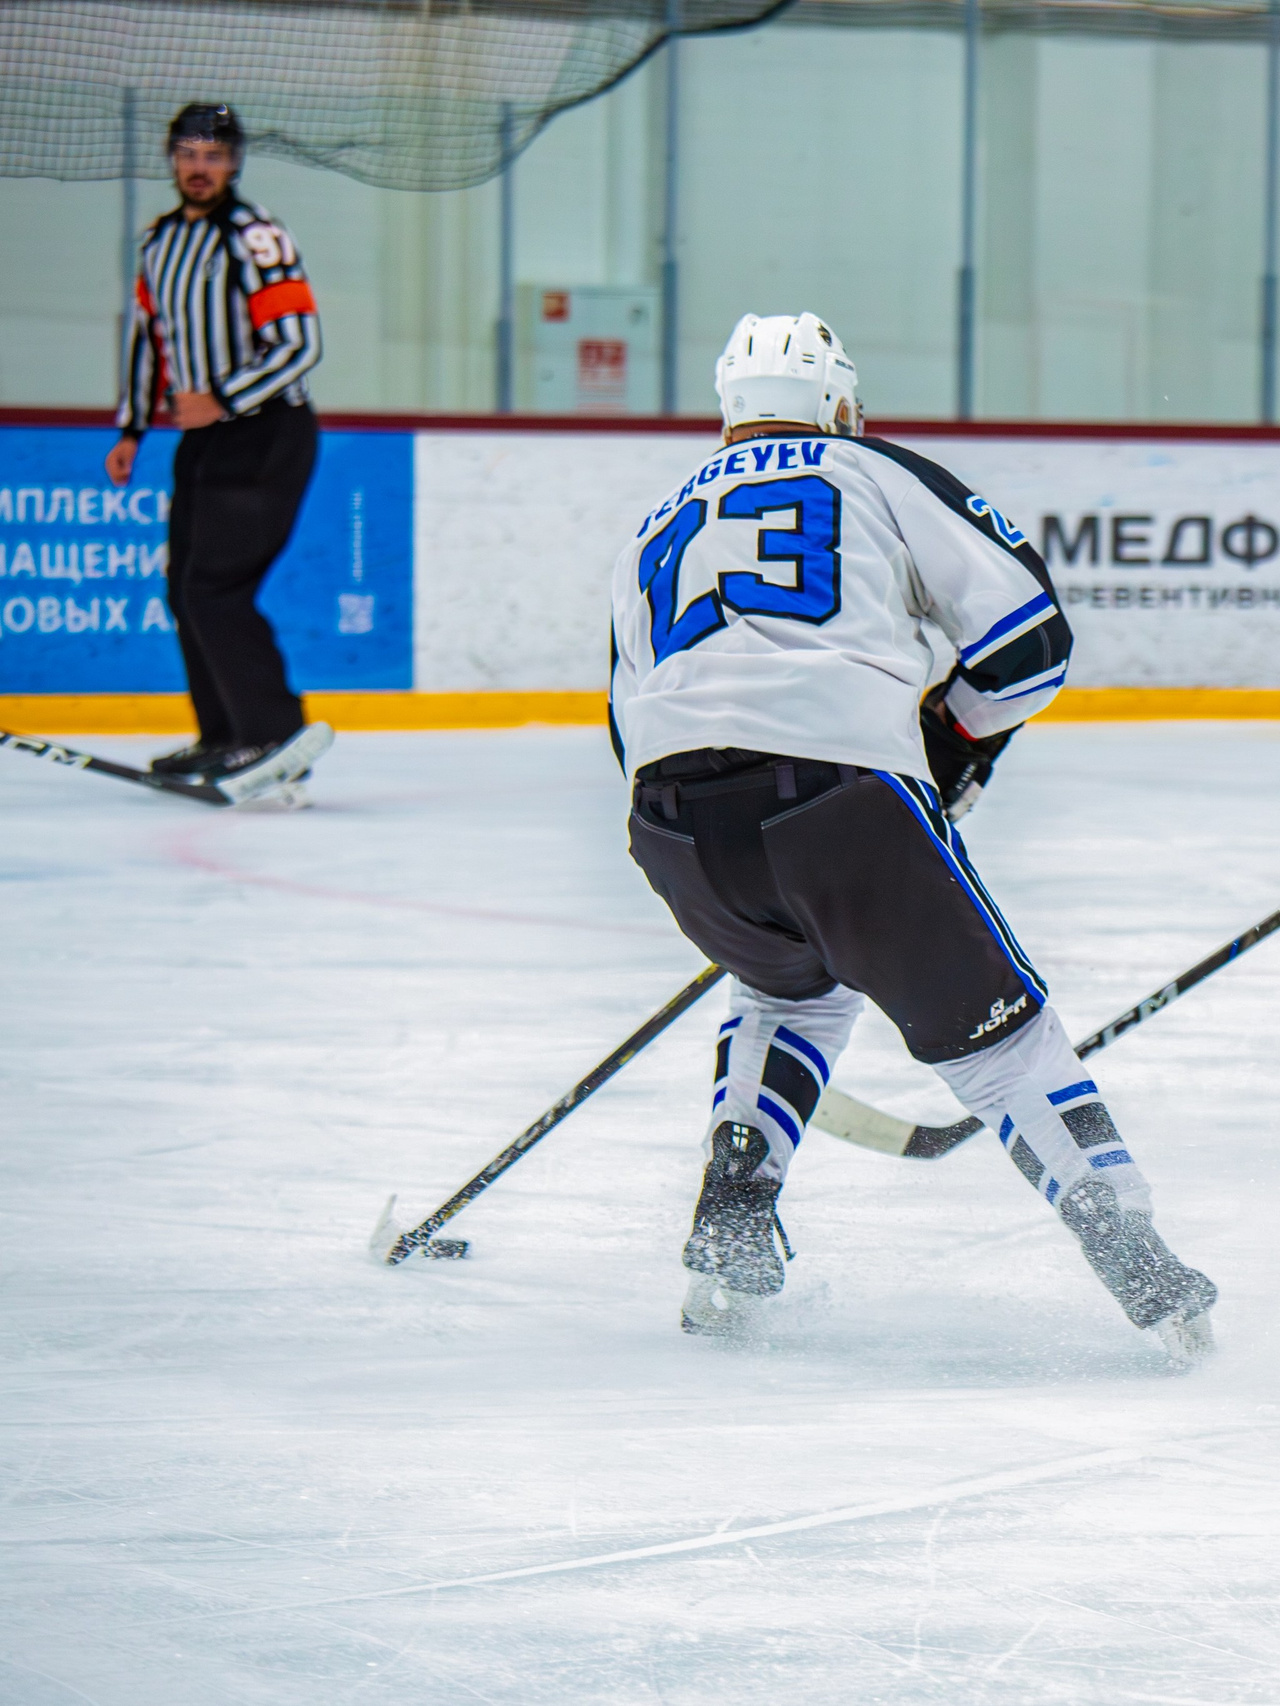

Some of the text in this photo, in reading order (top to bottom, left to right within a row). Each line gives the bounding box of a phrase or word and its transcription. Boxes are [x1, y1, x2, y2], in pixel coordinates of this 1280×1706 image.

[0, 543, 169, 585] АЩЕНИ
[638, 474, 842, 668] 23
[0, 597, 129, 638] ОВЫХ
